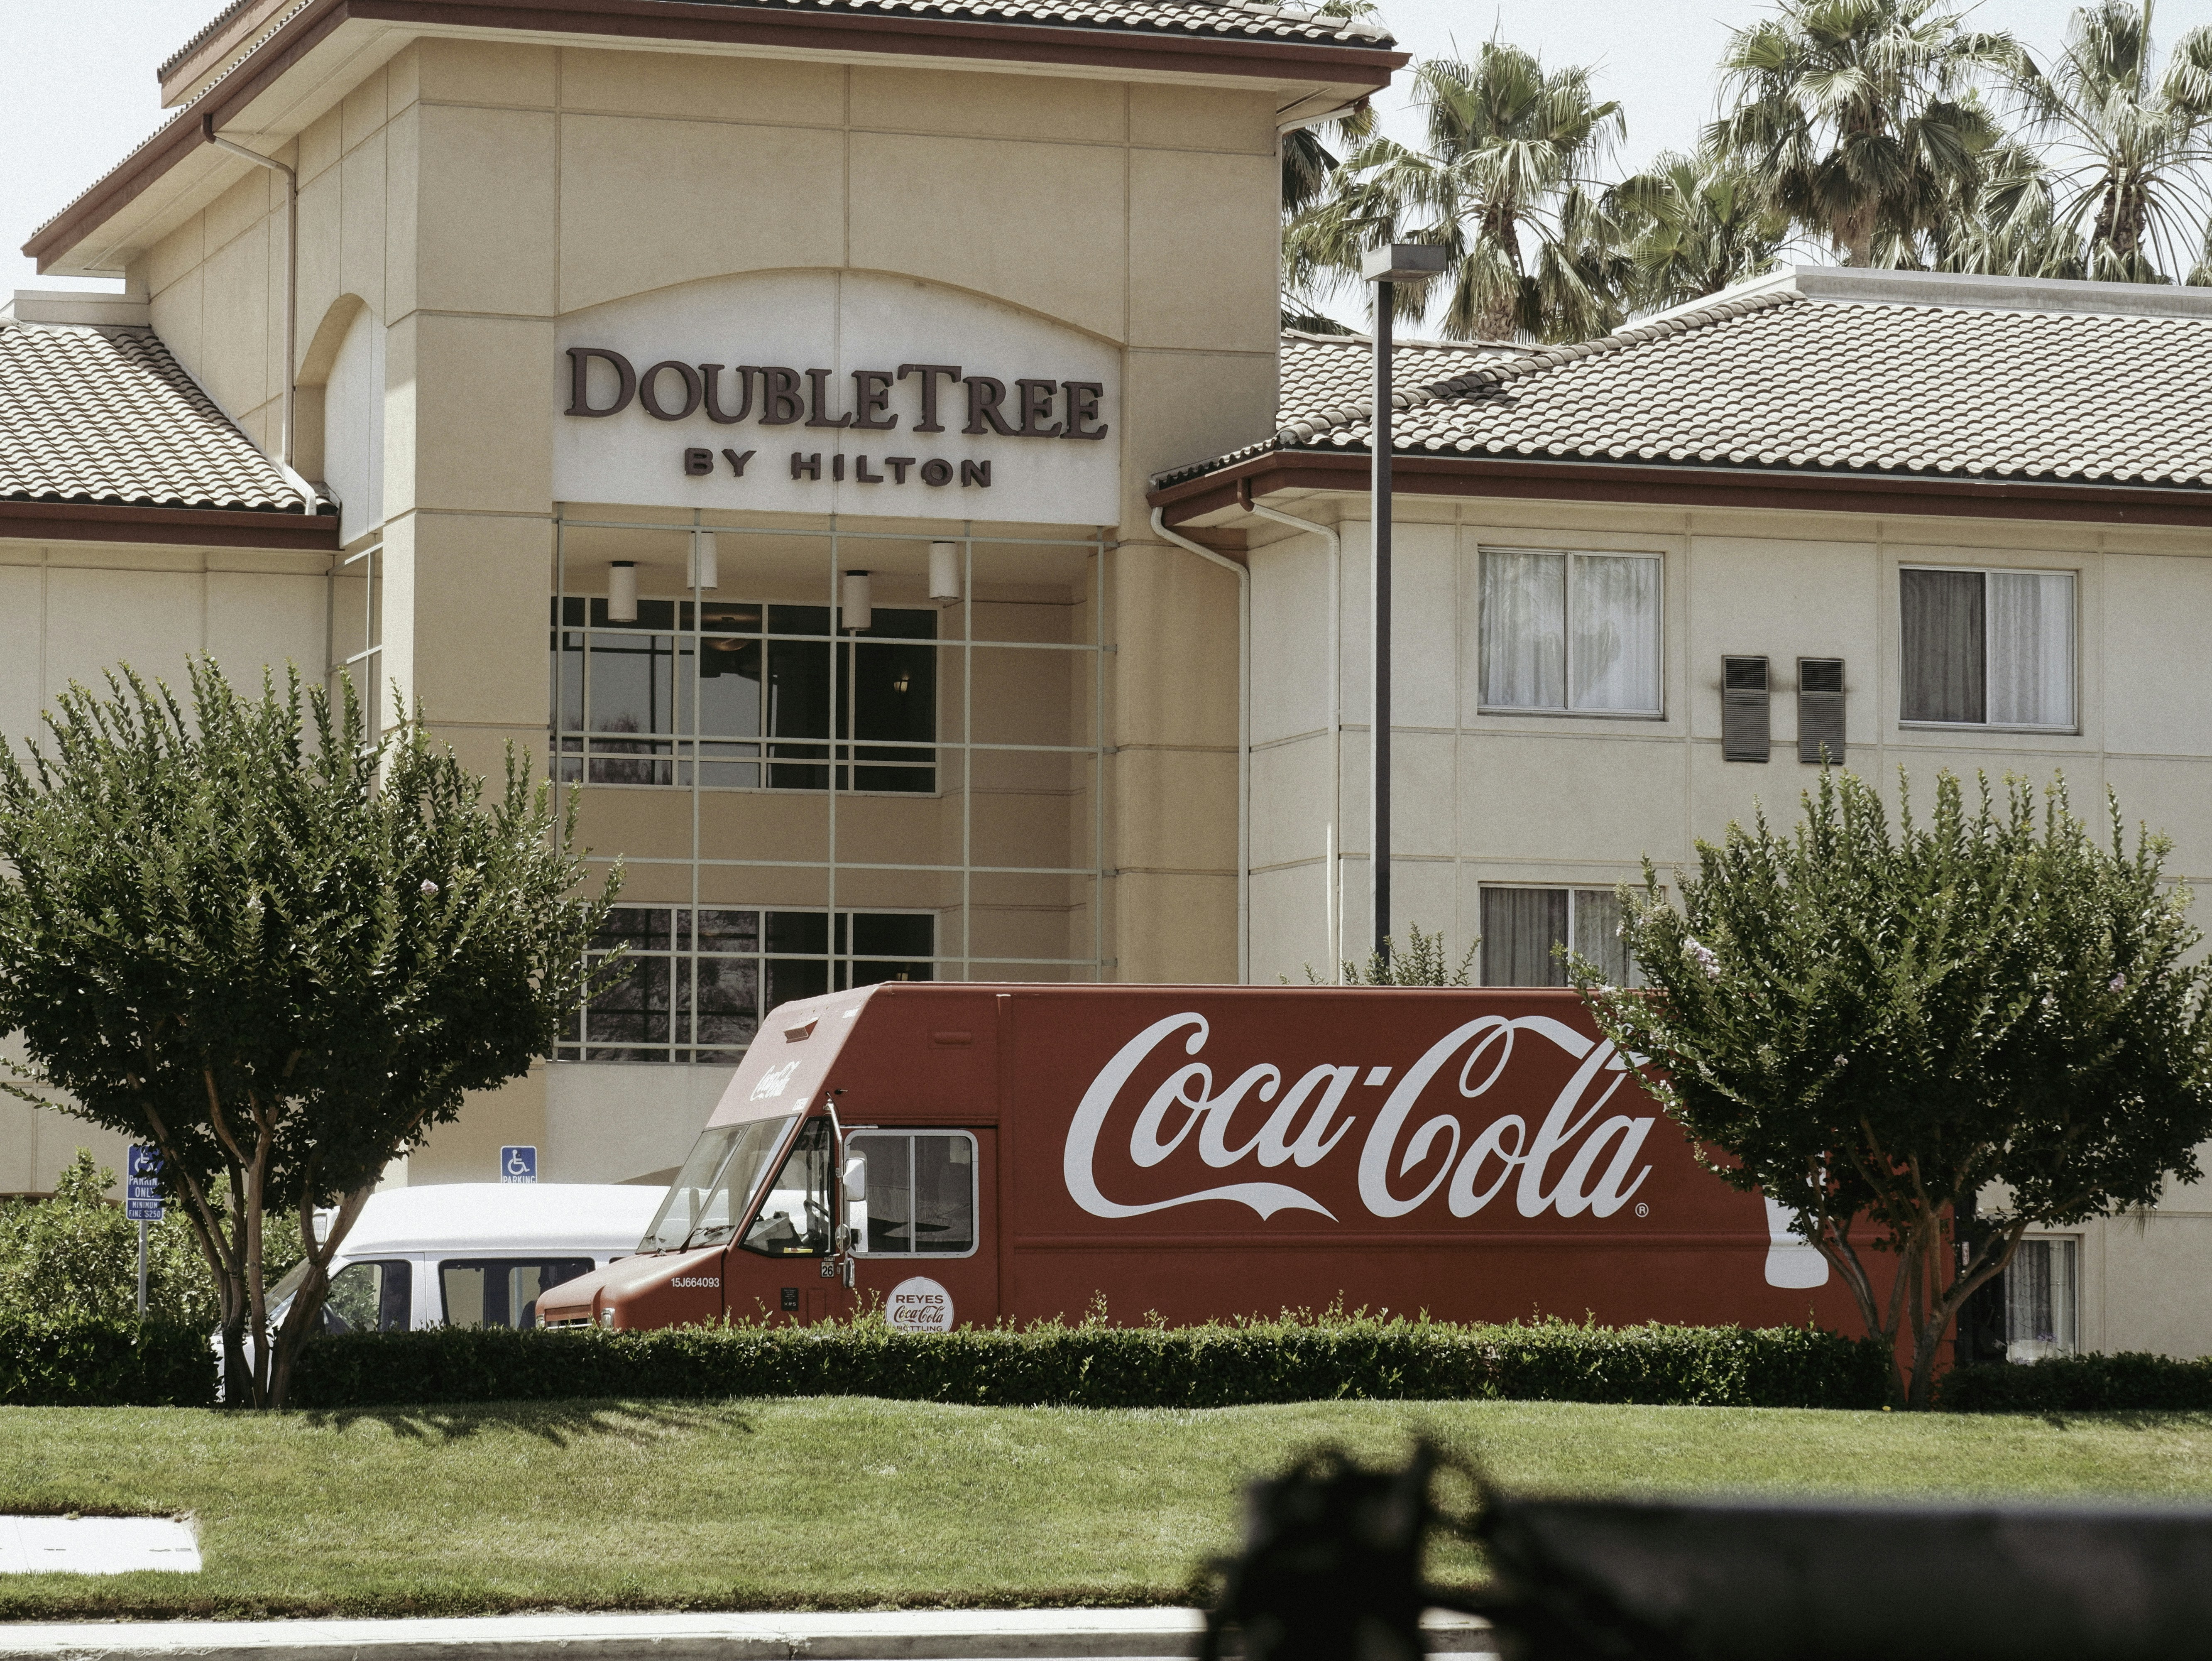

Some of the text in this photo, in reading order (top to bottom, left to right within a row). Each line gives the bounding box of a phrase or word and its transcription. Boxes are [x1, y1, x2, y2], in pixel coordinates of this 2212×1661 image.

[684, 448, 991, 488] BY HILTON
[1064, 1012, 1656, 1222] Coca-Cola
[129, 1175, 160, 1186] PARKIN
[822, 1265, 833, 1276] 26
[671, 1277, 719, 1287] 15J664093
[896, 1295, 944, 1304] REYES
[893, 1305, 945, 1323] Coca-Cola
